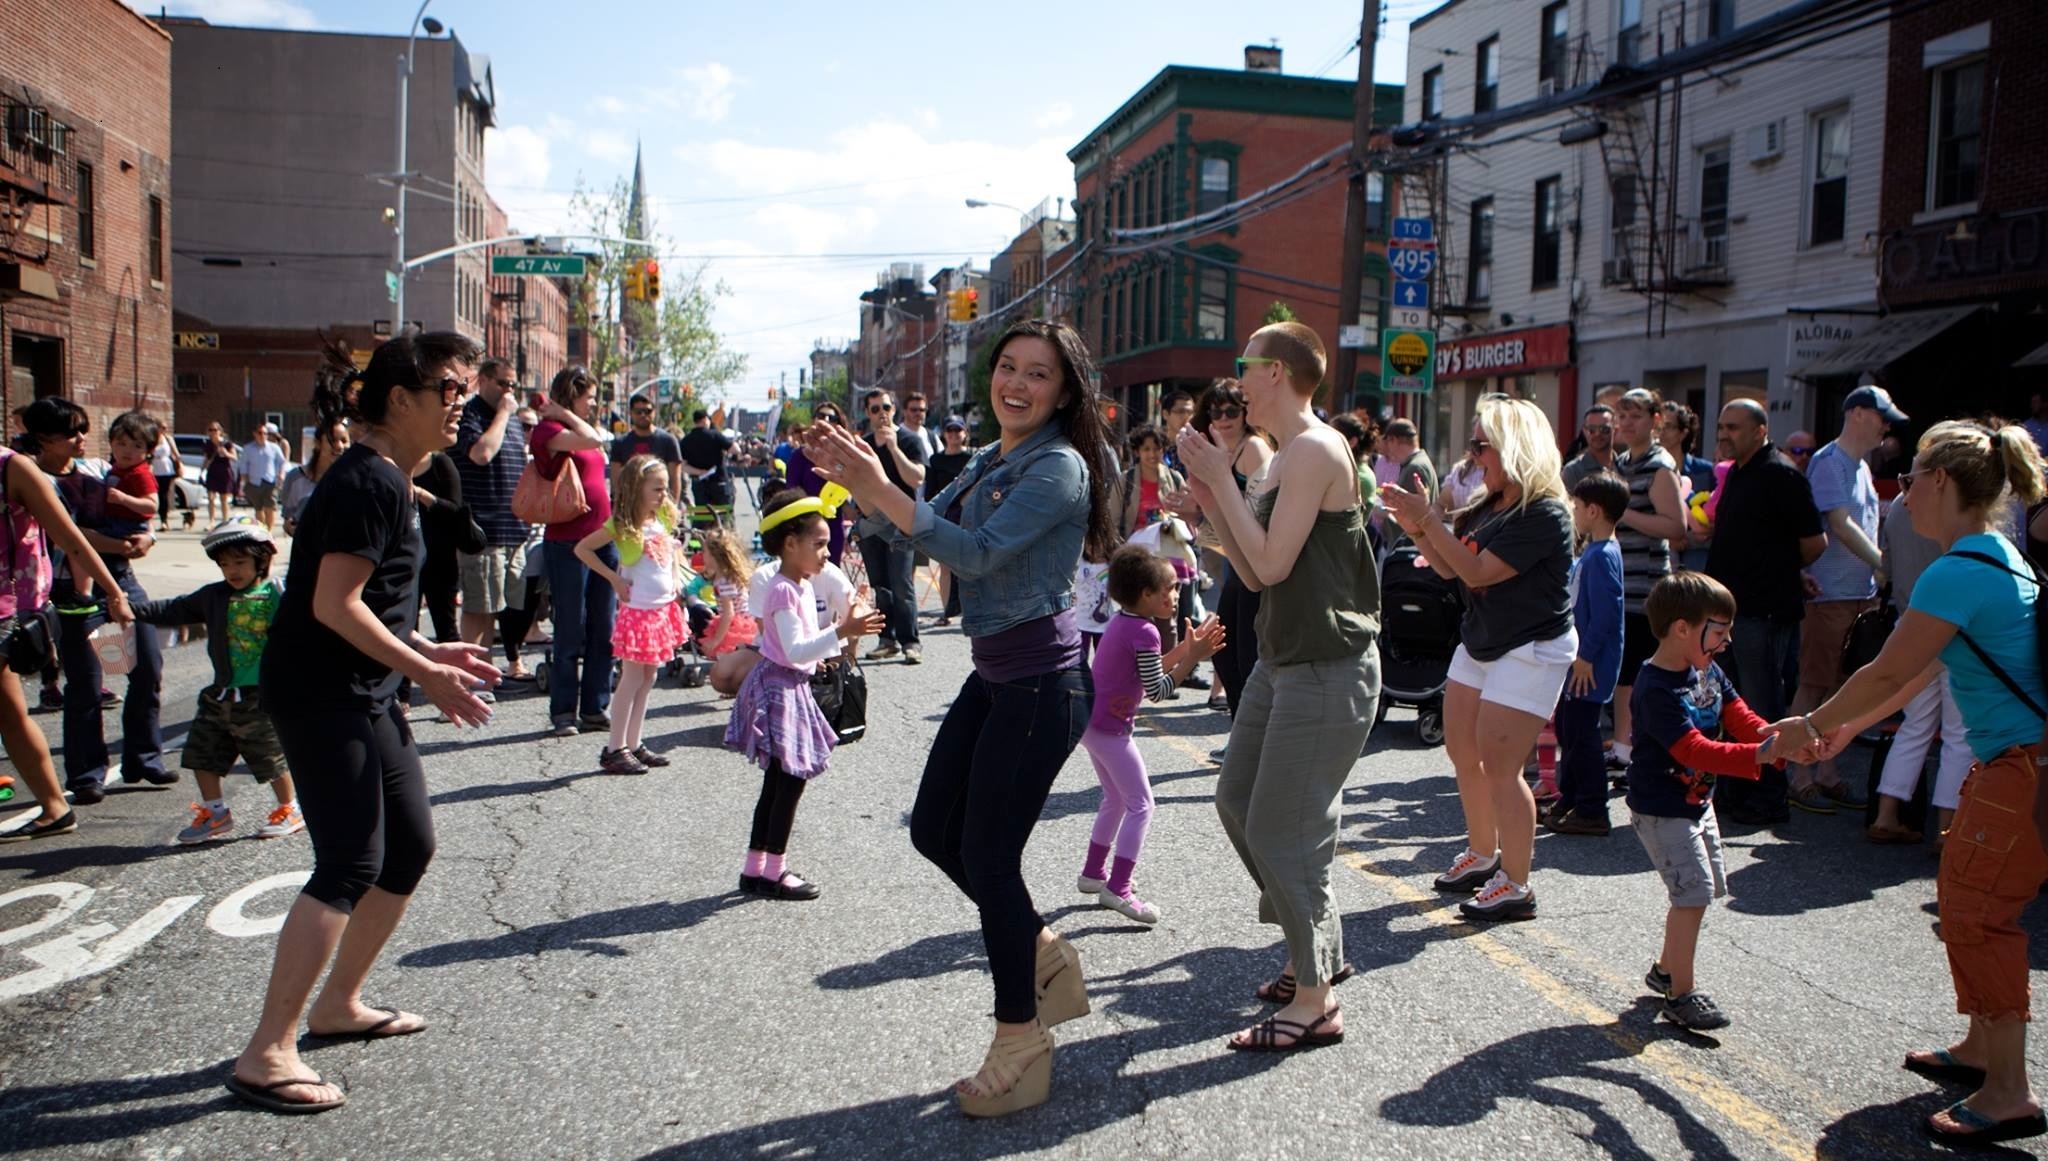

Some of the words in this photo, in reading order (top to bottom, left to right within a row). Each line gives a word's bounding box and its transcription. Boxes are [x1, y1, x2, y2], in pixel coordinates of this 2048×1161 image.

[1404, 222, 1422, 235] TO
[515, 260, 535, 271] 47
[542, 260, 561, 272] Av
[1393, 250, 1431, 273] 495
[1402, 312, 1419, 324] TO
[1437, 344, 1461, 374] EY'S
[1465, 340, 1523, 369] BURGER
